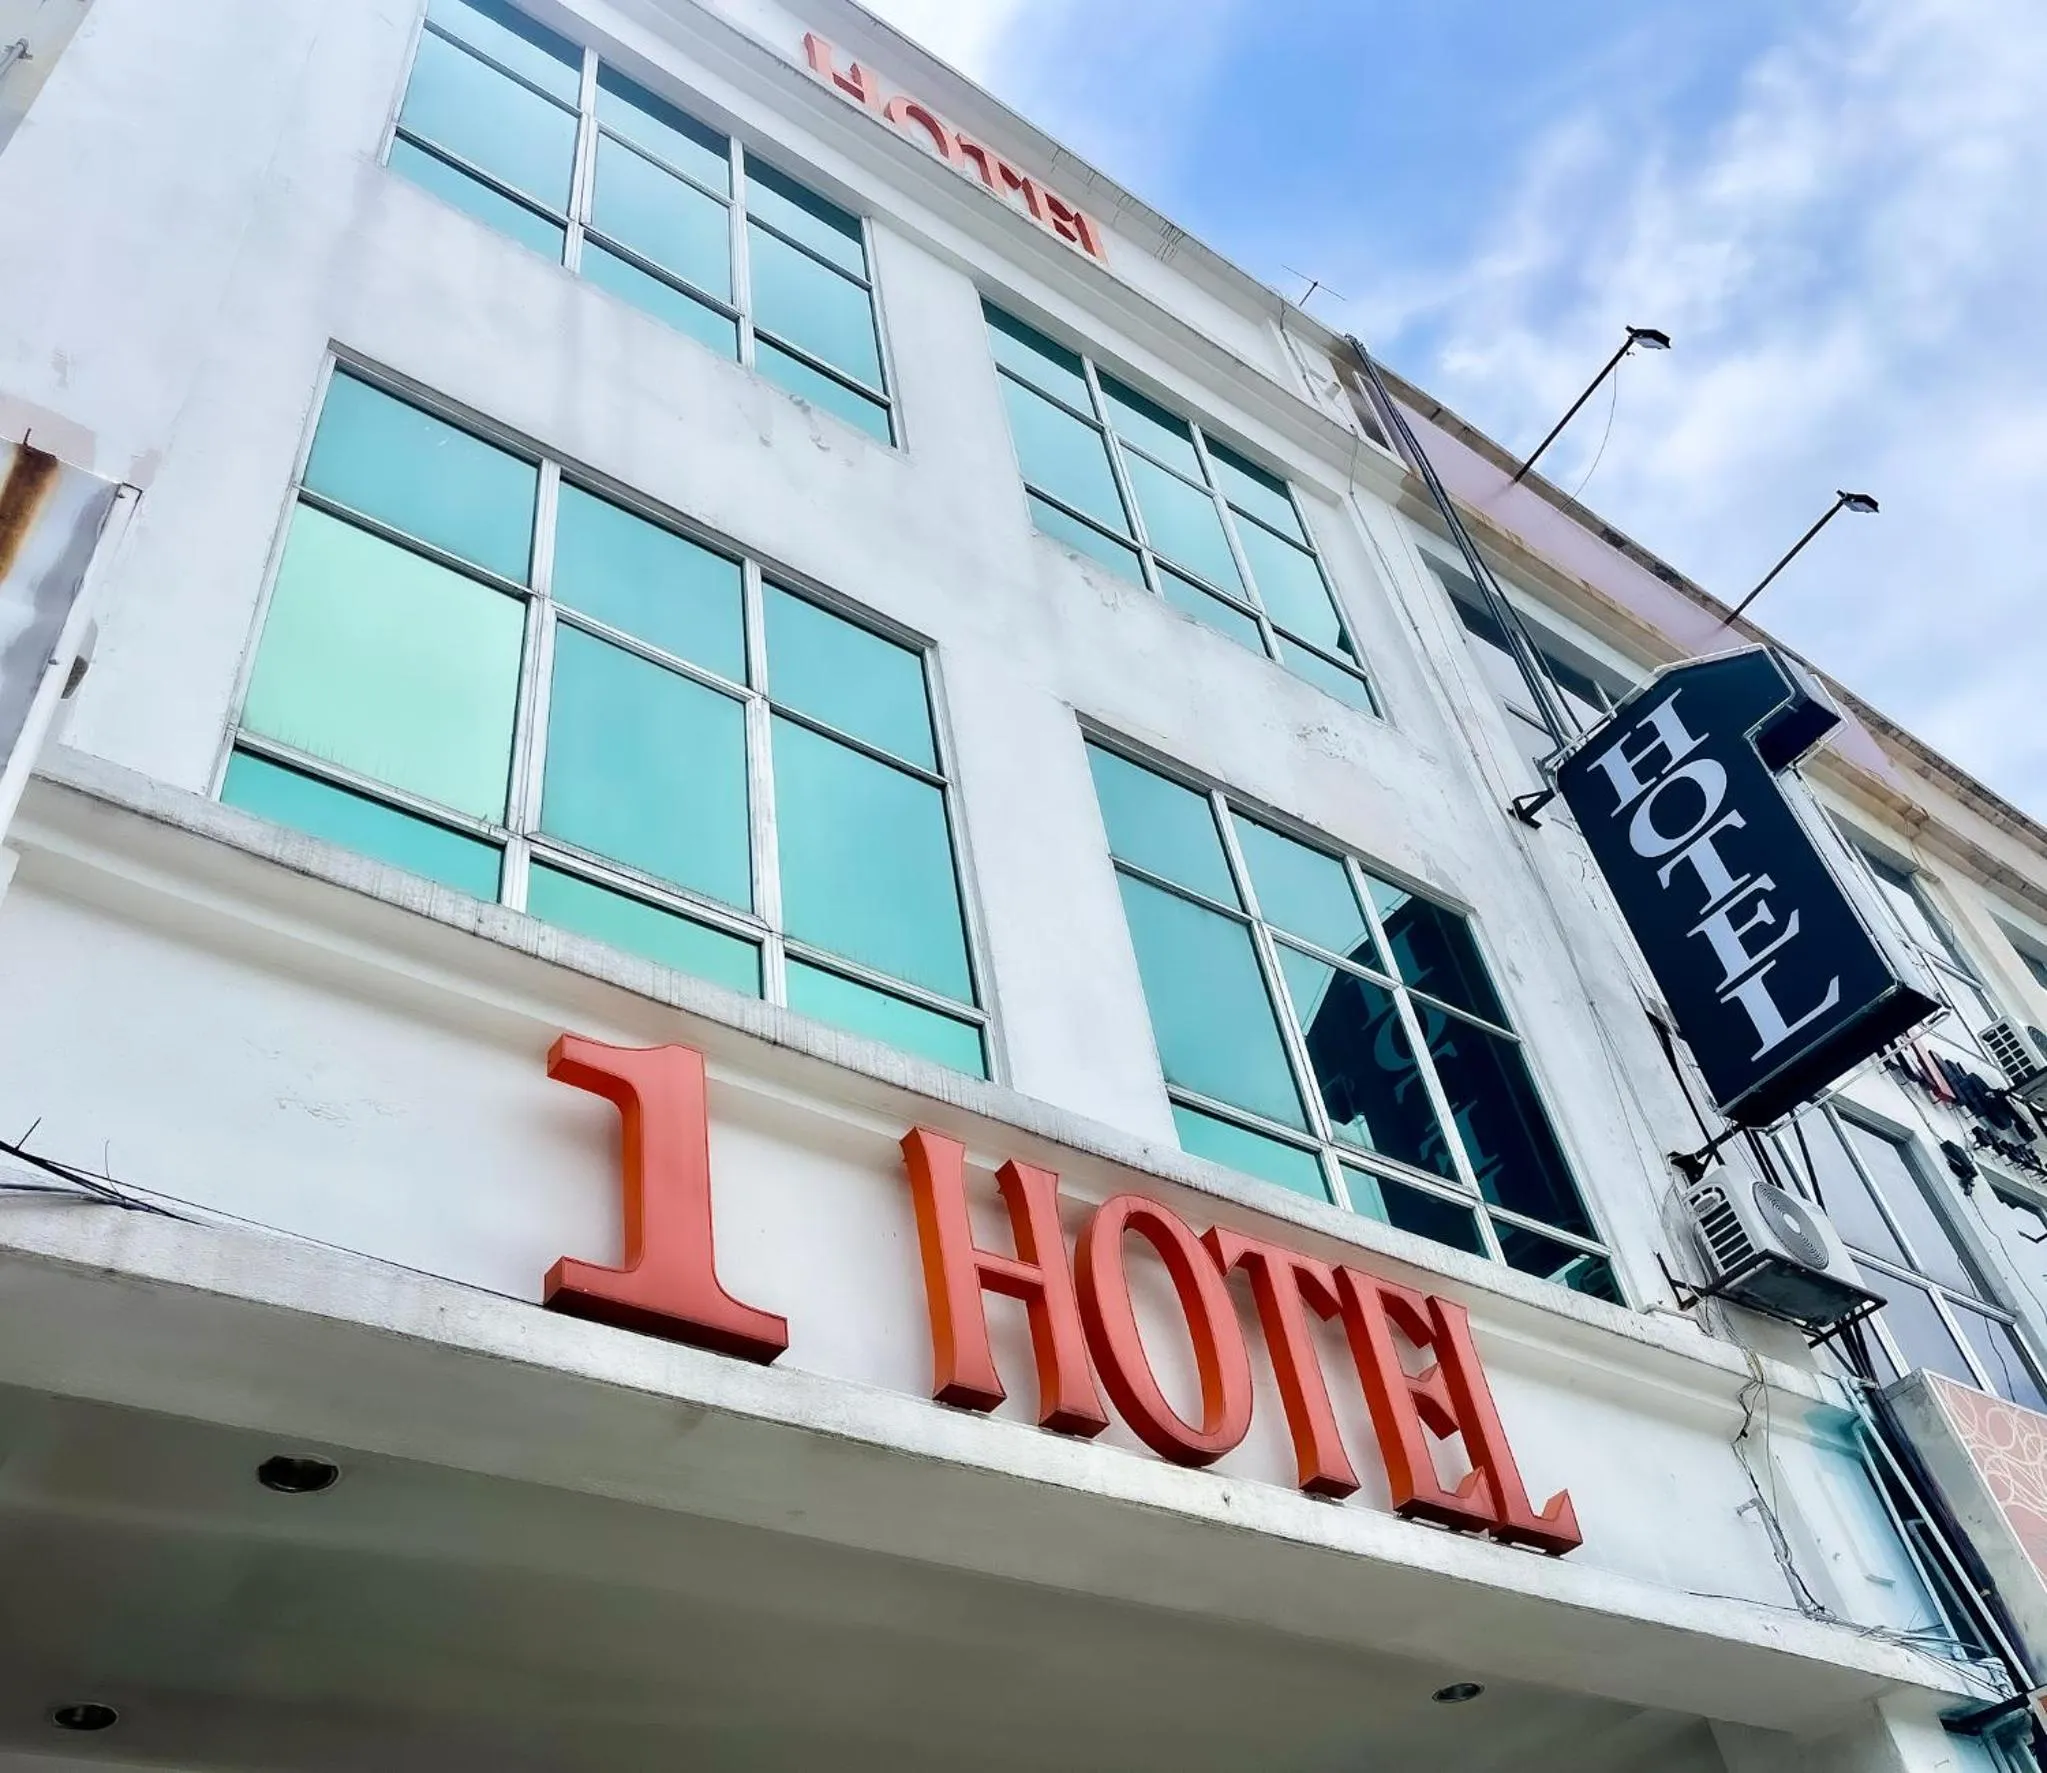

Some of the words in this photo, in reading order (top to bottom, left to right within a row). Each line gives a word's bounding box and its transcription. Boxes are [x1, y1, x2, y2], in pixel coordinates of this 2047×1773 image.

[1586, 687, 1842, 1063] HOTEL
[544, 1033, 789, 1365] 1
[900, 1126, 1583, 1557] HOTEL
